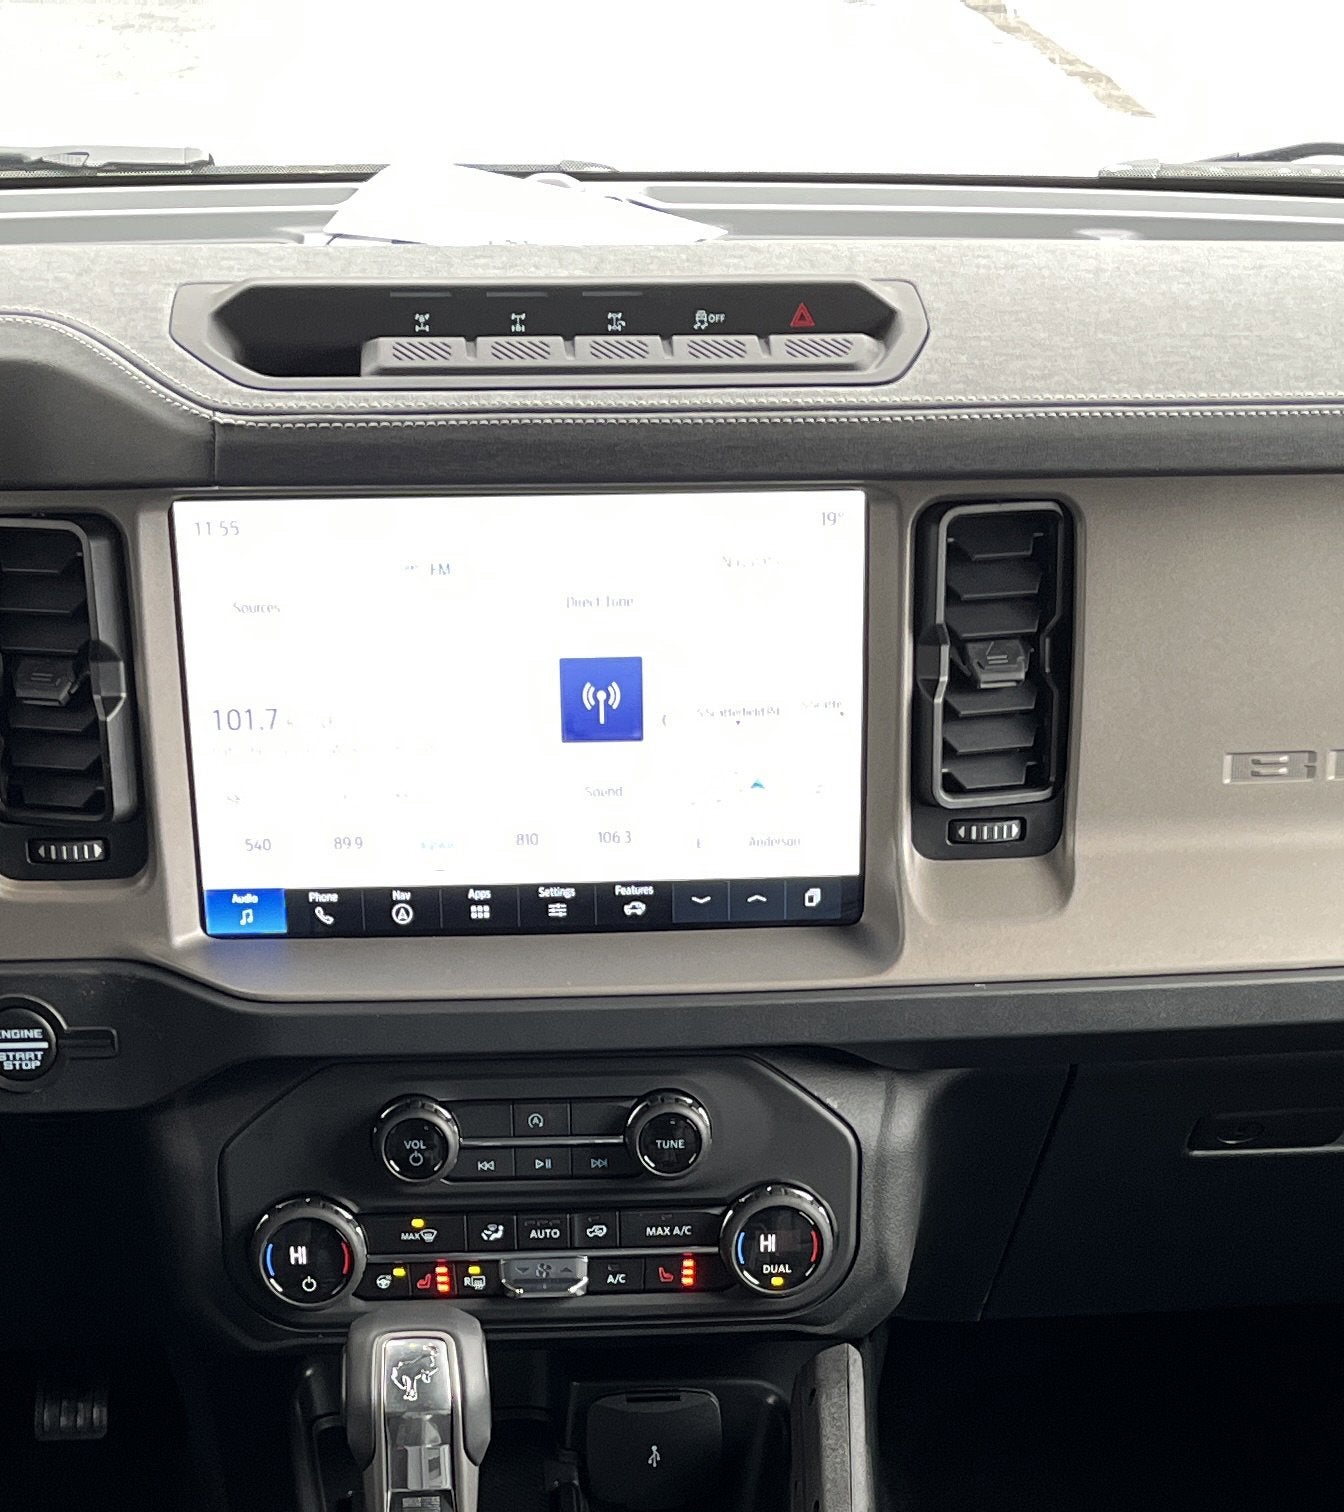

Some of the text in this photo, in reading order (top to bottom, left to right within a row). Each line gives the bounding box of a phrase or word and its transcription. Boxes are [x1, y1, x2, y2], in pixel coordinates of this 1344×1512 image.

[708, 313, 725, 323] OFF
[194, 520, 239, 536] 1155
[213, 708, 278, 731] 101.7
[333, 836, 363, 850] 899
[516, 832, 539, 846] 810
[597, 830, 632, 844] 1063
[244, 838, 272, 852] 540
[392, 889, 411, 901] Nav
[467, 888, 492, 901] Apps
[538, 886, 576, 899] Settings
[614, 884, 654, 896] Features
[231, 893, 258, 904] Audio
[308, 891, 338, 903] Phone
[2, 1060, 41, 1071] STOP
[403, 1139, 426, 1150] VOL
[655, 1139, 686, 1149] TUNE
[401, 1232, 420, 1241] MAX
[529, 1228, 560, 1239] AUTO
[645, 1225, 692, 1236] MAX A/C
[759, 1233, 776, 1253] HI
[289, 1245, 306, 1265] HI
[762, 1263, 792, 1274] DUAL
[607, 1273, 626, 1284] A/C
